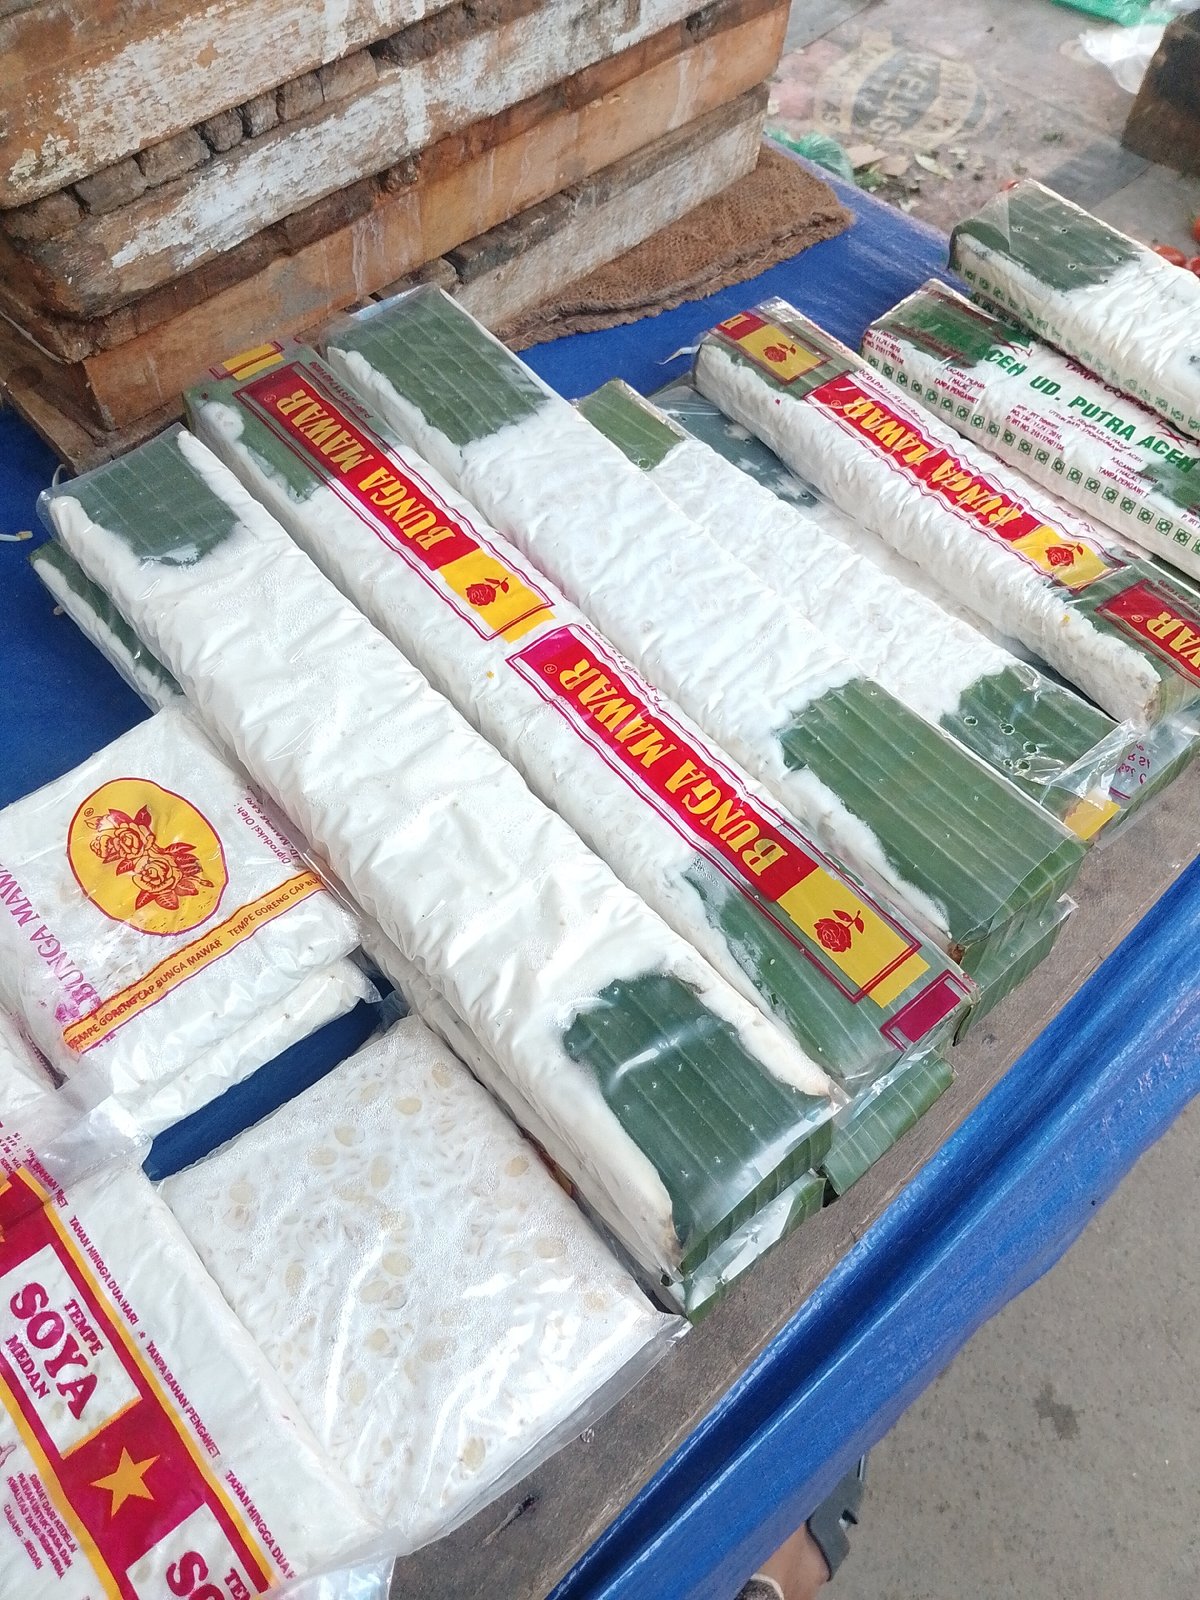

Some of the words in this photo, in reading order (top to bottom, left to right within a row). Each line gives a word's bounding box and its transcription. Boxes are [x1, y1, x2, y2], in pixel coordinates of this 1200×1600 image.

[275, 388, 375, 473] MAWAR
[1067, 395, 1137, 441] PUTRA
[1136, 434, 1200, 474] ACEH
[356, 466, 456, 551] BUNGA
[557, 658, 677, 769] MAWAR
[251, 824, 292, 864] Diproduksi
[664, 758, 788, 877] BUNGA
[30, 924, 98, 1006] BUNGA
[135, 985, 154, 1000] CAP
[155, 962, 188, 988] BUNGA
[186, 938, 223, 966] MAWAR
[227, 913, 256, 936] TEMPE
[254, 893, 290, 916] GORENG
[289, 883, 305, 896] CAP
[69, 1215, 91, 1247] TAHAN
[86, 1246, 112, 1282] HINGGA
[107, 1280, 124, 1302] DUA
[120, 1300, 139, 1326] HARI
[5, 1334, 51, 1399] MEDAN
[9, 1282, 99, 1420] SOYA
[64, 1298, 104, 1356] TEMPE
[146, 1340, 168, 1375] TANPA
[163, 1373, 190, 1408] BAHAN
[185, 1407, 220, 1458] PENGAWET
[25, 1513, 41, 1536] YANG
[42, 1500, 57, 1521] DARI
[46, 1527, 63, 1551] RASA
[59, 1549, 72, 1568] DAN
[226, 1470, 252, 1507] TAHAN
[247, 1505, 275, 1549] HINGGA
[271, 1546, 289, 1574] DUA
[24, 1540, 43, 1570] MEDAN
